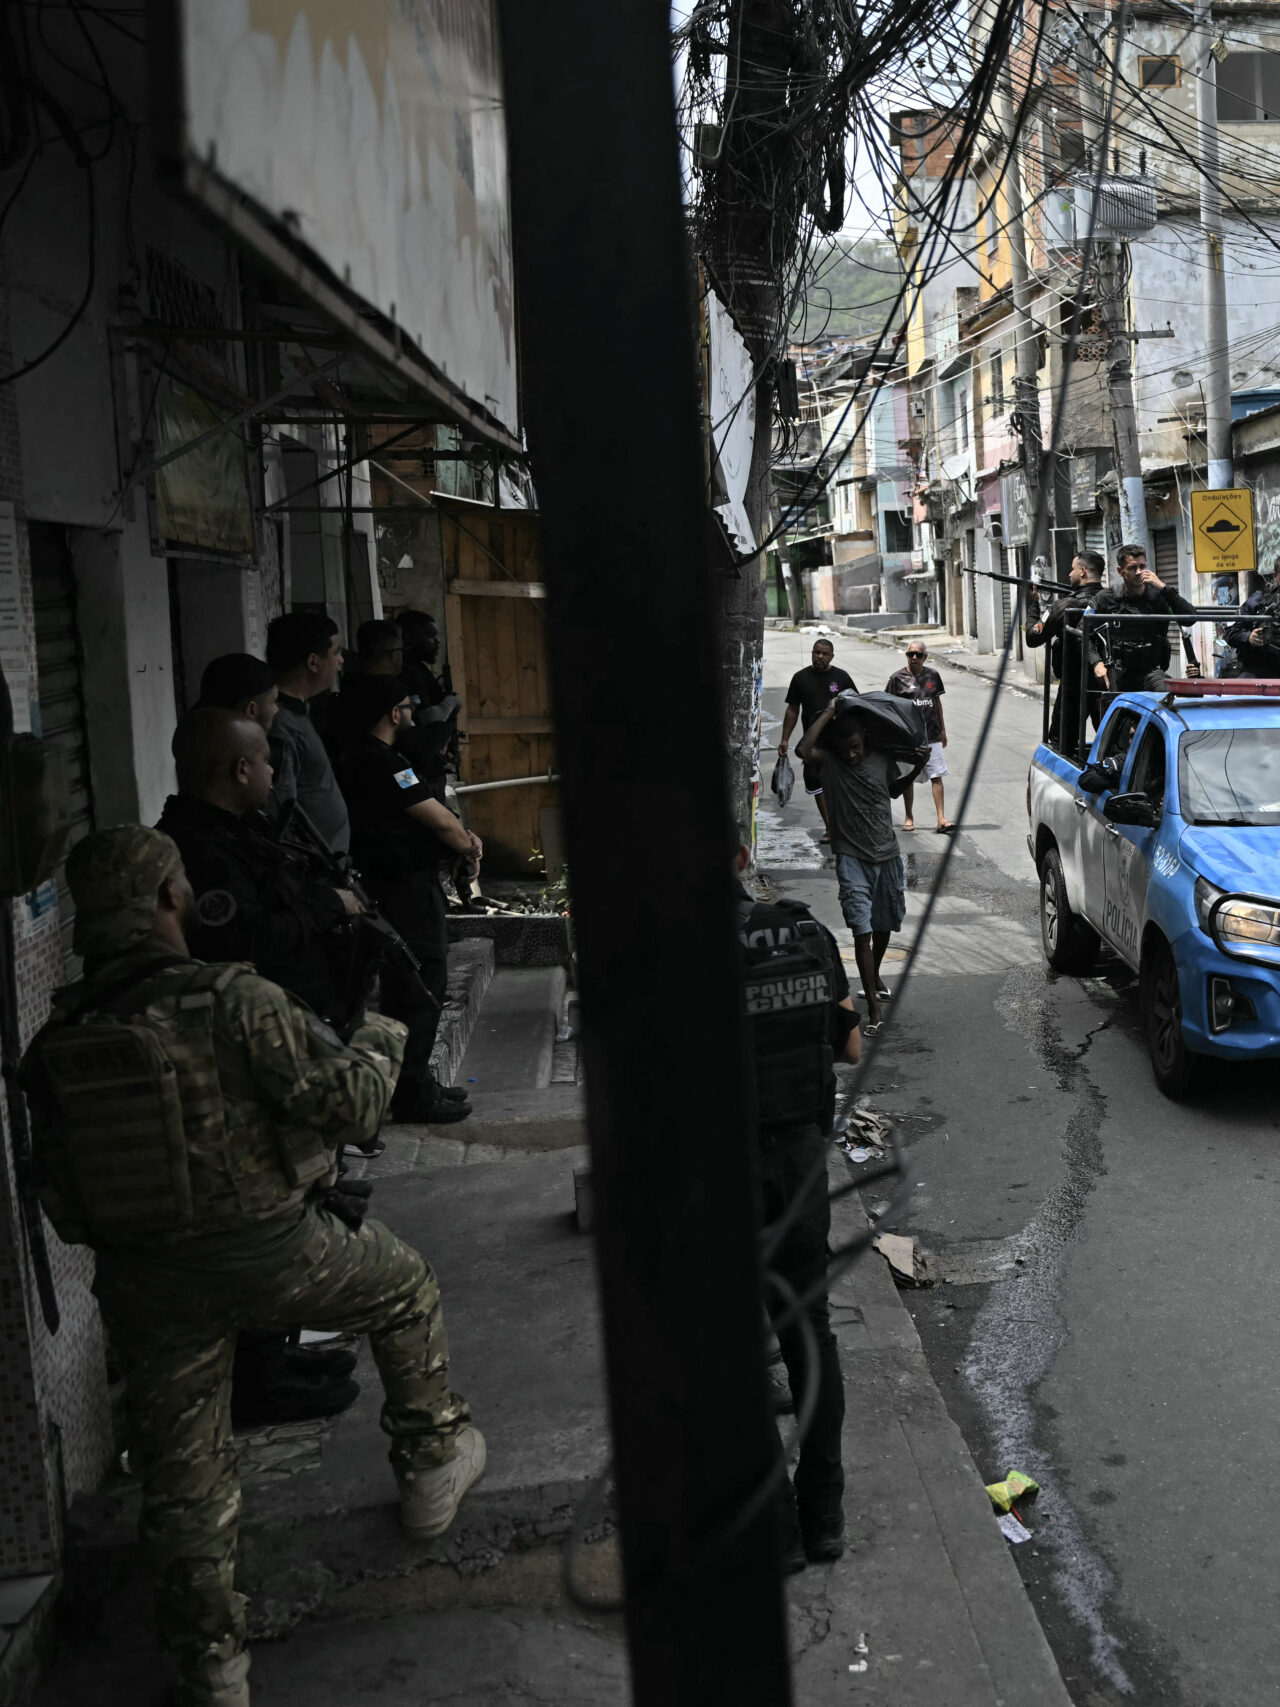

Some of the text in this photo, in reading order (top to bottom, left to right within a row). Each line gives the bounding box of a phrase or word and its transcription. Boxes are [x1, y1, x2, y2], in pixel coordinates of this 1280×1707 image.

[1106, 898, 1138, 958] POLÍCIA
[745, 974, 828, 1000] POLÍCIA
[746, 988, 829, 1012] CIVIL
